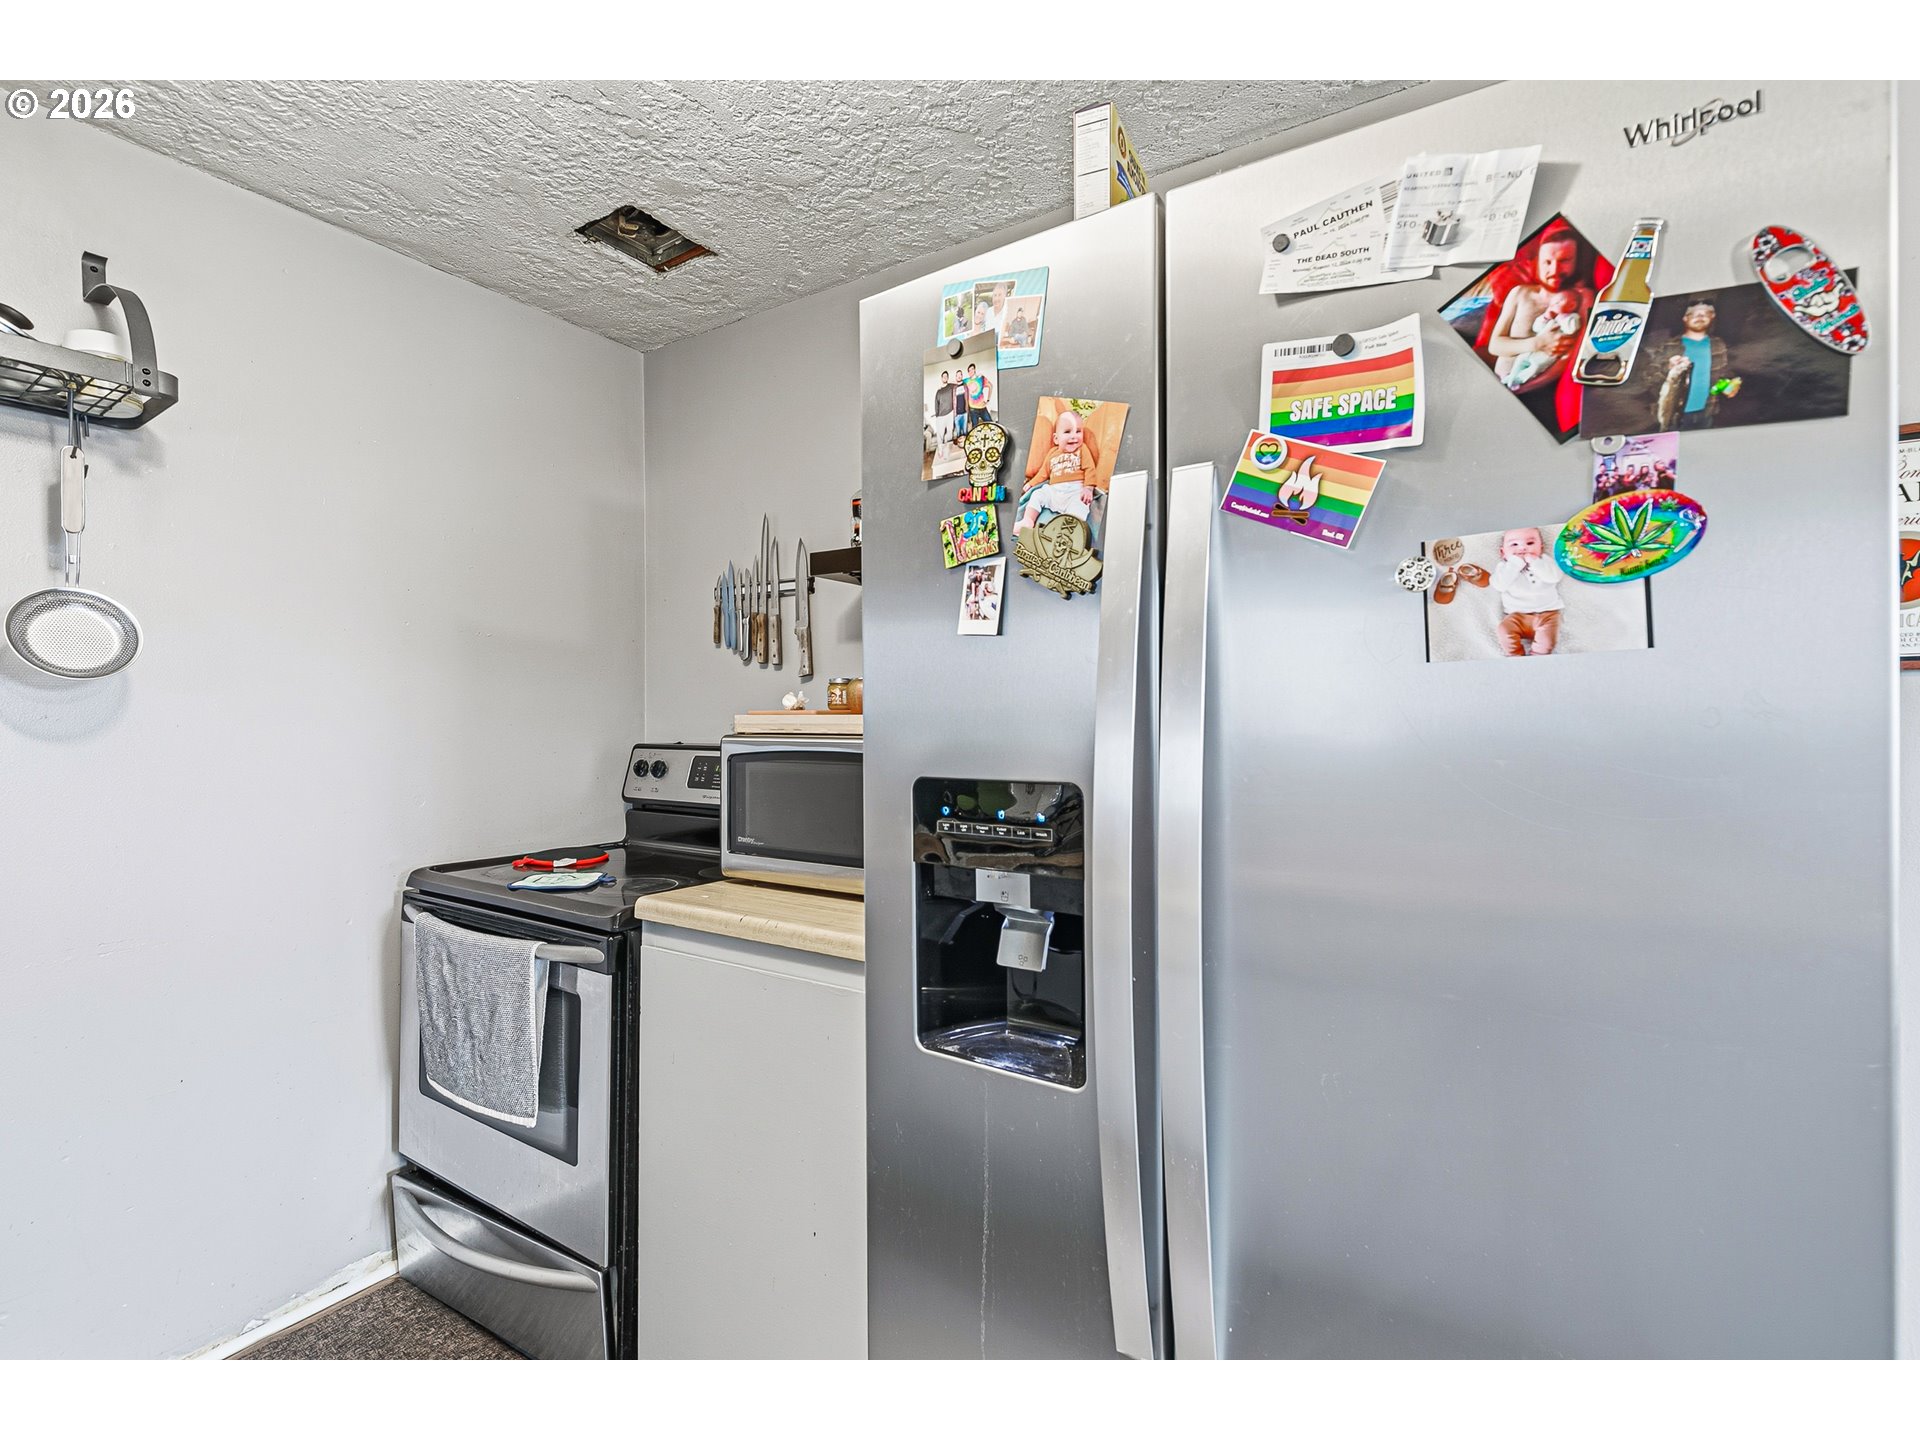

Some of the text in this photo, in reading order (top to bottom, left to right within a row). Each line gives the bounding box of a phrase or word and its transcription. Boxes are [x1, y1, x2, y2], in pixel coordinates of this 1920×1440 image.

[1624, 89, 1762, 148] Whirlpool
[1293, 223, 1320, 240] PAUL
[1322, 199, 1374, 227] CAUTHEN
[1297, 246, 1370, 265] THE DEAD SOUTH
[1289, 385, 1398, 423] SAFE SPACE
[1048, 560, 1092, 592] Caribbean
